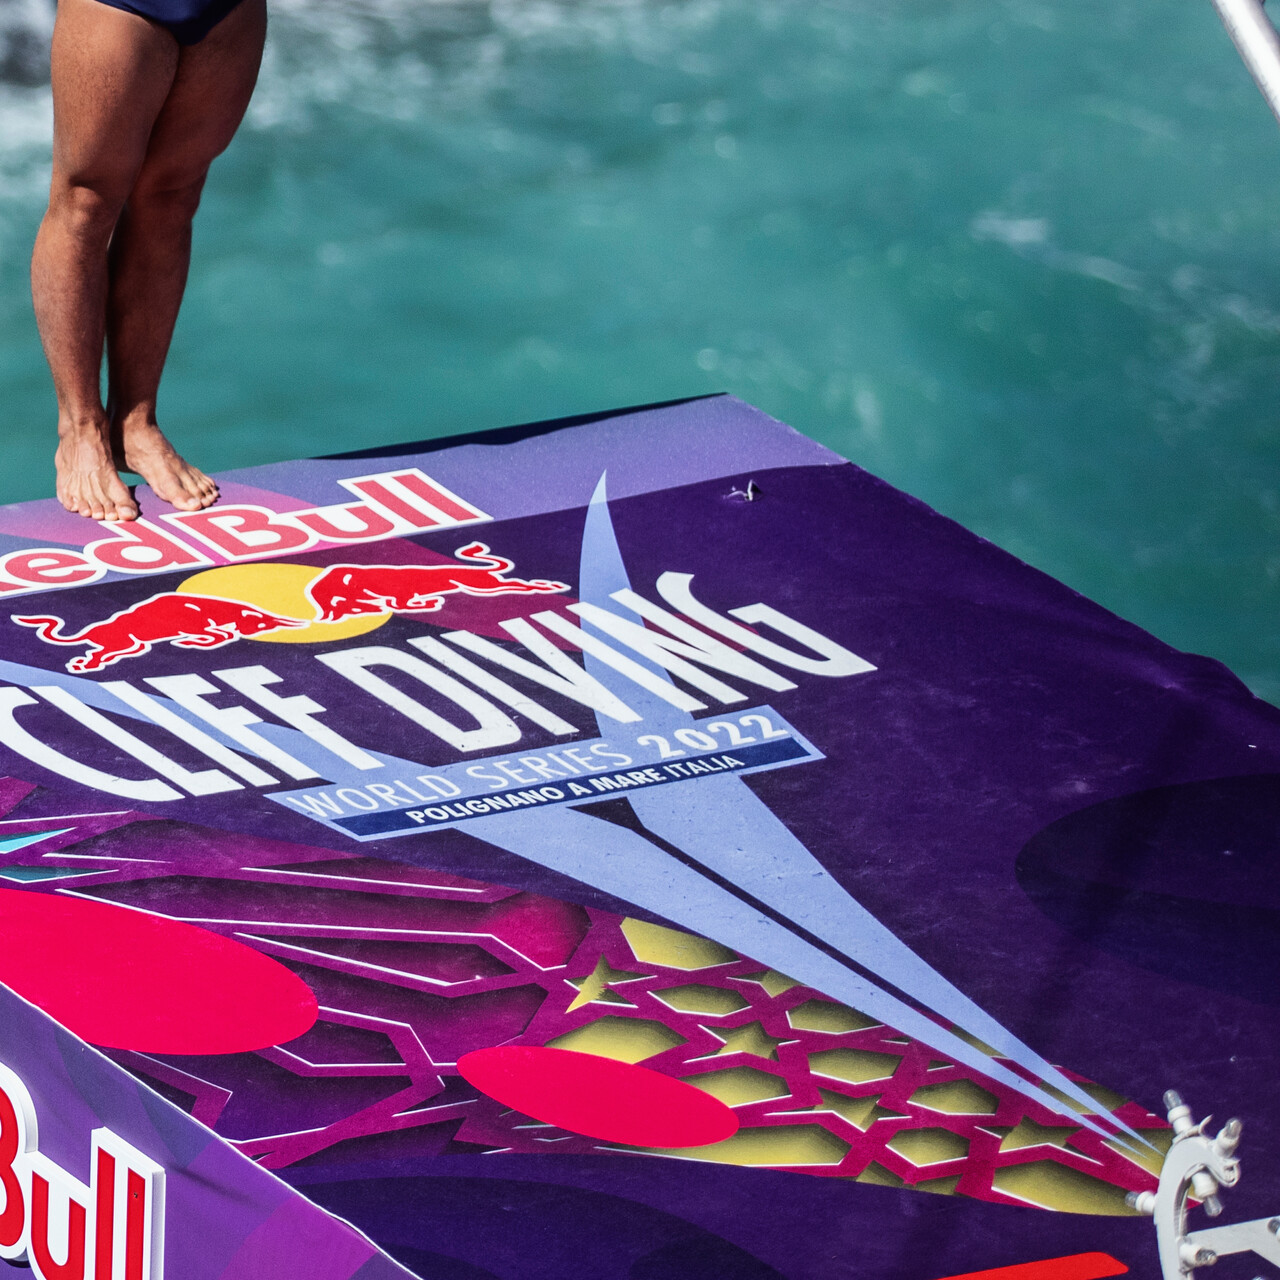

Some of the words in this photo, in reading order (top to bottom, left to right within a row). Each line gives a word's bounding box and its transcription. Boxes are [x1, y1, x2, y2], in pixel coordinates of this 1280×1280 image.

[164, 470, 490, 560] Bull
[314, 571, 878, 752] DIVING
[286, 773, 462, 818] WORLD
[466, 742, 634, 789] SERIES
[637, 715, 790, 759] 2022
[405, 785, 565, 825] POLIGNANO
[569, 776, 591, 795] A
[593, 767, 667, 792] MARE
[668, 754, 745, 780] ITALIA
